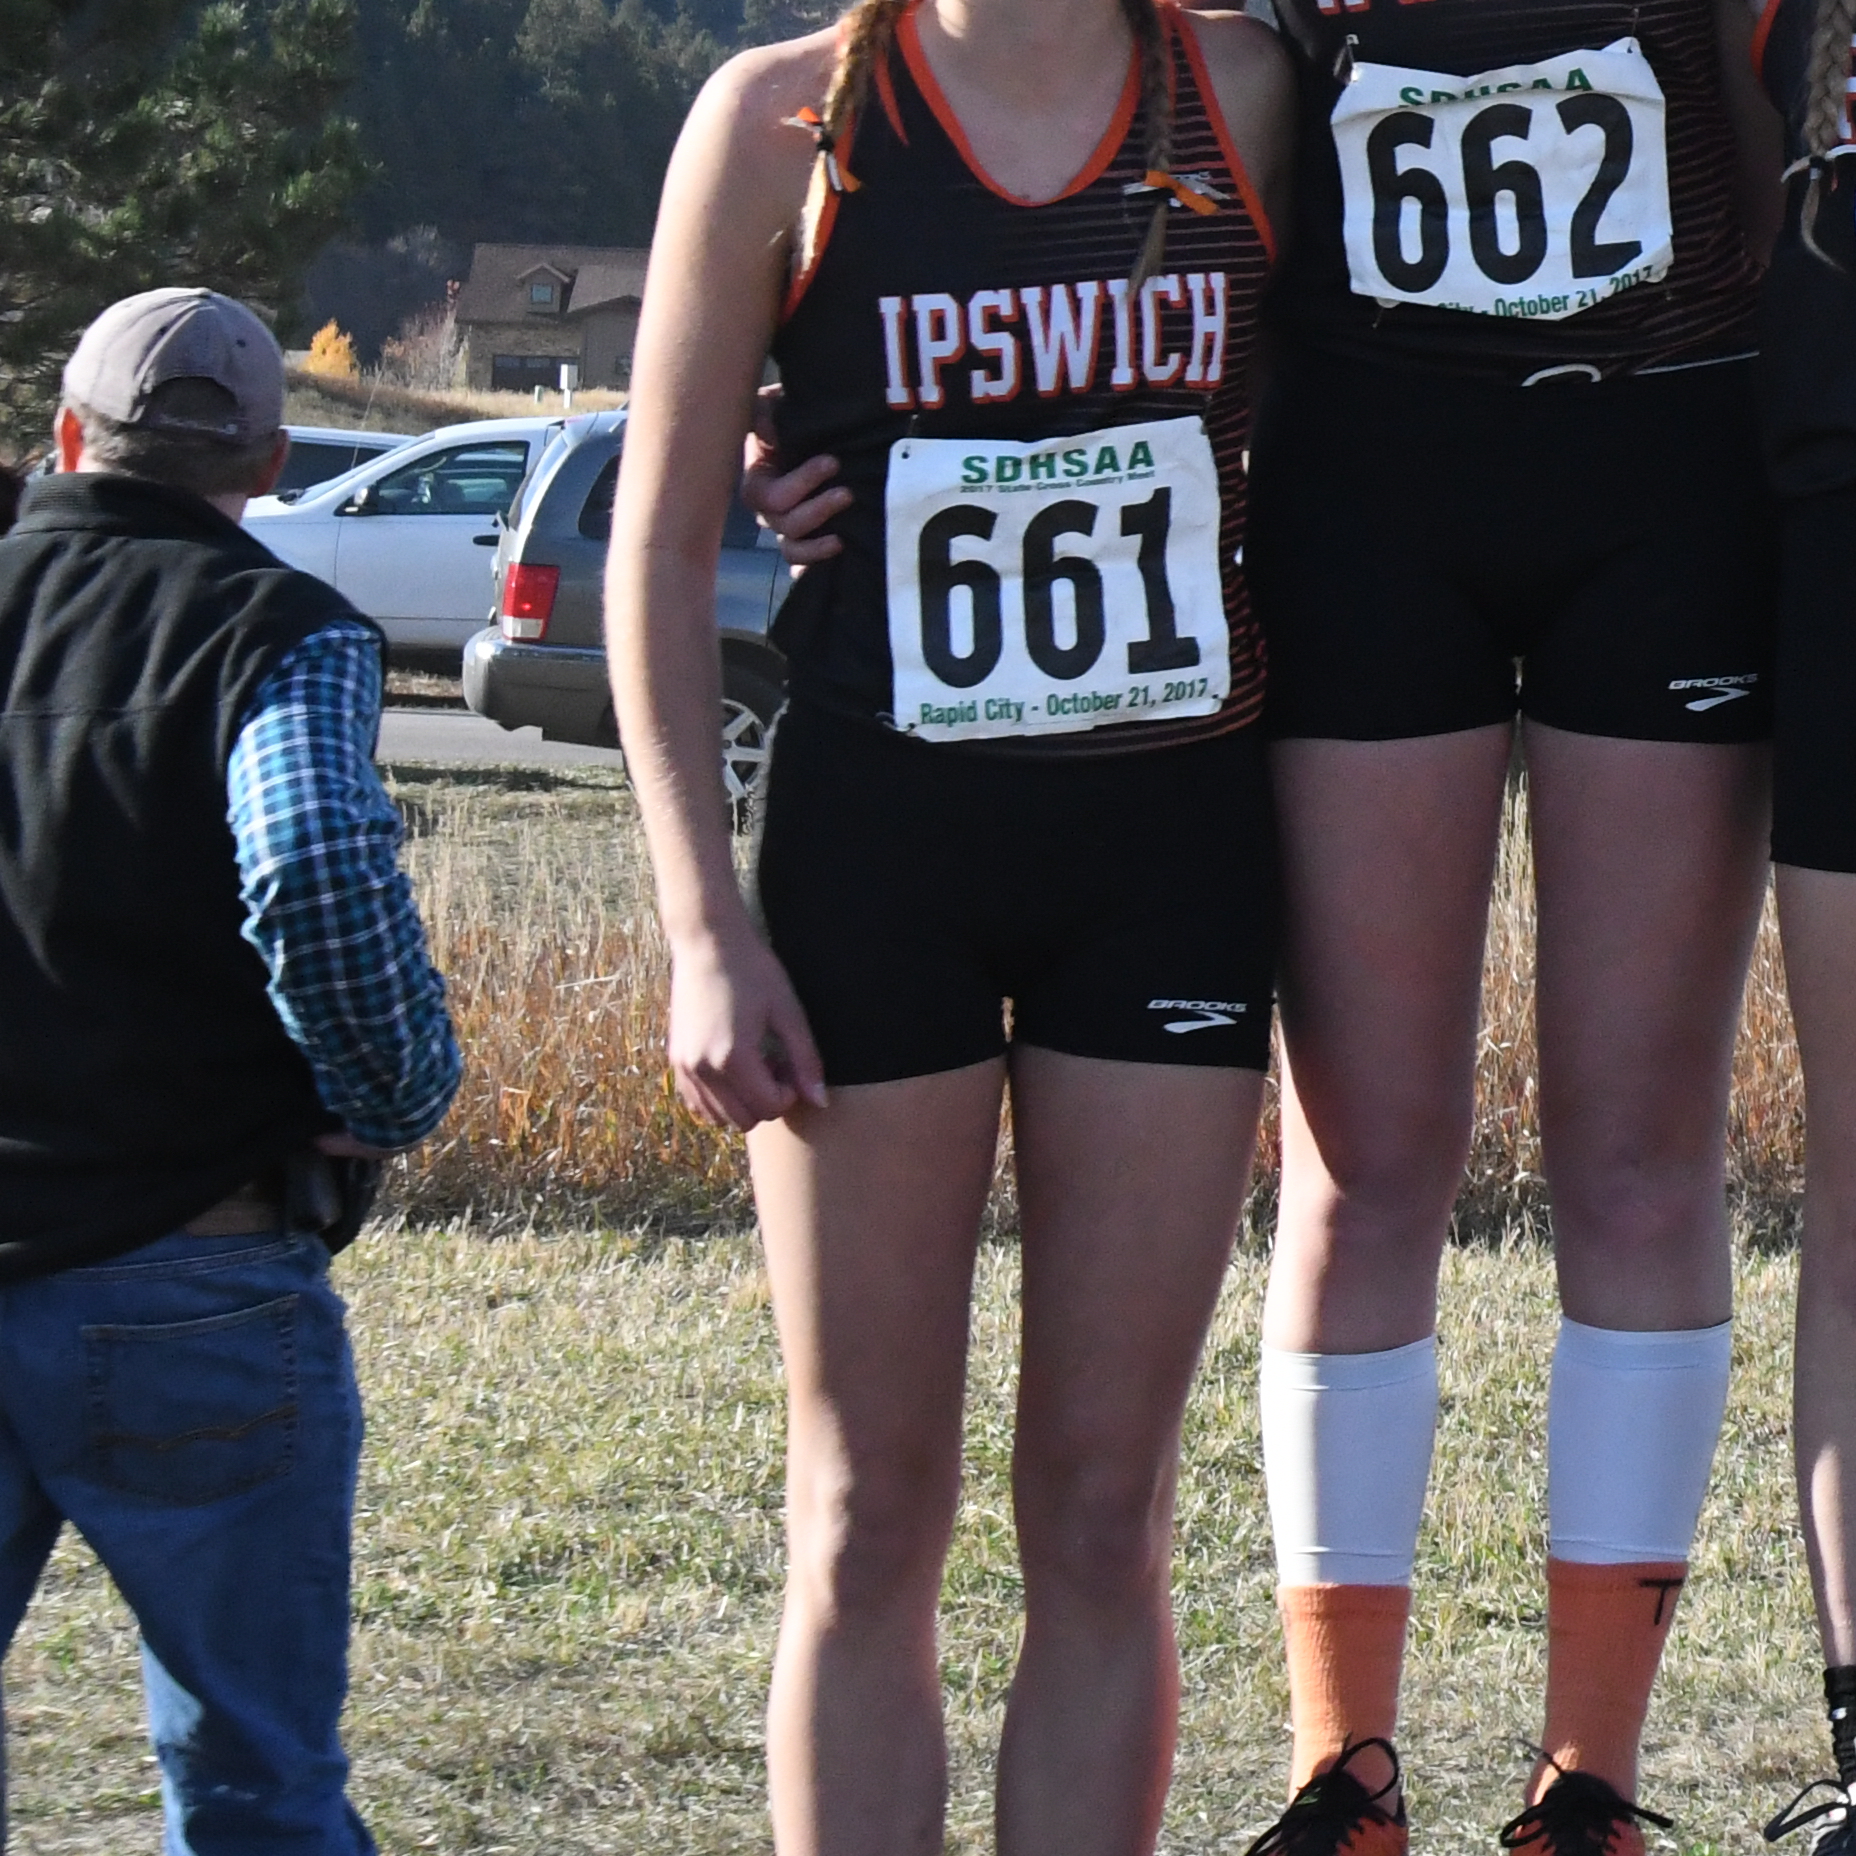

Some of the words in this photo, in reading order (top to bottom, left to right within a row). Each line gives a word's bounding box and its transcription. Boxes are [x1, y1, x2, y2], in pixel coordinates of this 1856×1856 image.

[1366, 93, 1642, 293] 662
[1495, 295, 1570, 317] October
[879, 272, 1230, 409] IPSWICH
[961, 440, 1155, 484] SDHSAA
[919, 486, 1201, 688] 661
[920, 700, 977, 727] Rapid
[985, 698, 1025, 722] City
[1047, 690, 1122, 716] October
[1128, 686, 1156, 708] 21,
[1163, 678, 1209, 702] 2017
[1668, 673, 1758, 690] BROOKS
[1146, 1000, 1248, 1012] BROOKS
